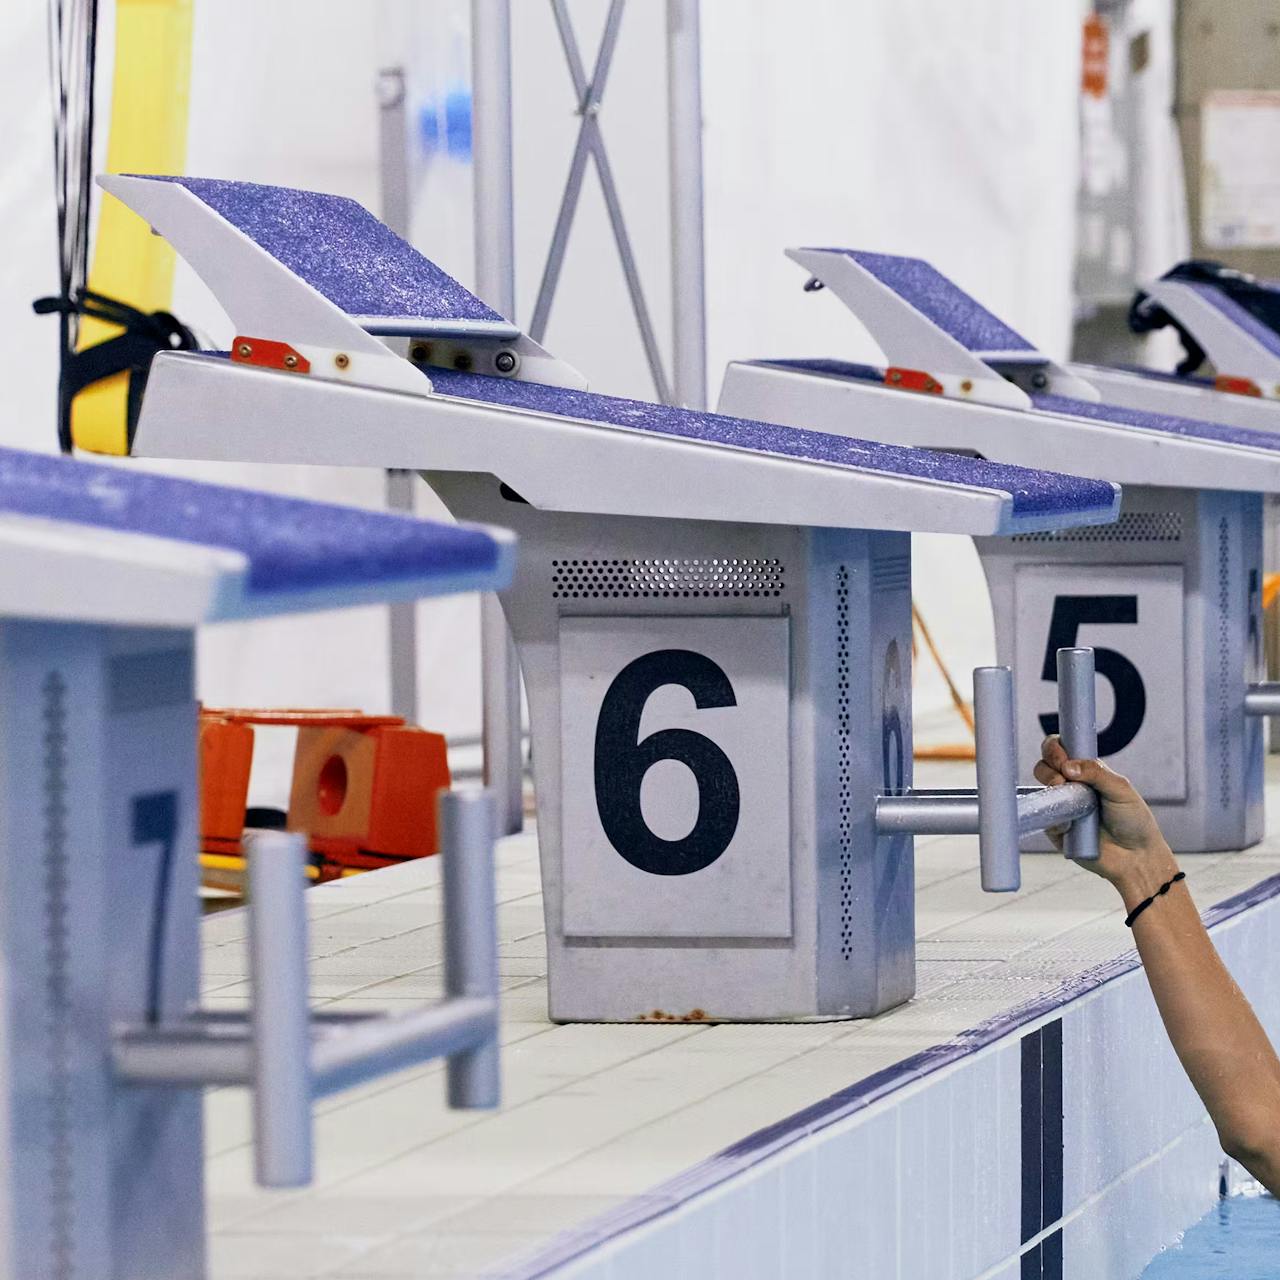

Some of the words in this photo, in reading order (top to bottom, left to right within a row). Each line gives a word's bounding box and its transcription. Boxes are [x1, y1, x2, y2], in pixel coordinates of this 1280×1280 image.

[593, 649, 740, 875] 6
[1038, 595, 1146, 758] 5
[130, 789, 179, 1029] 7
